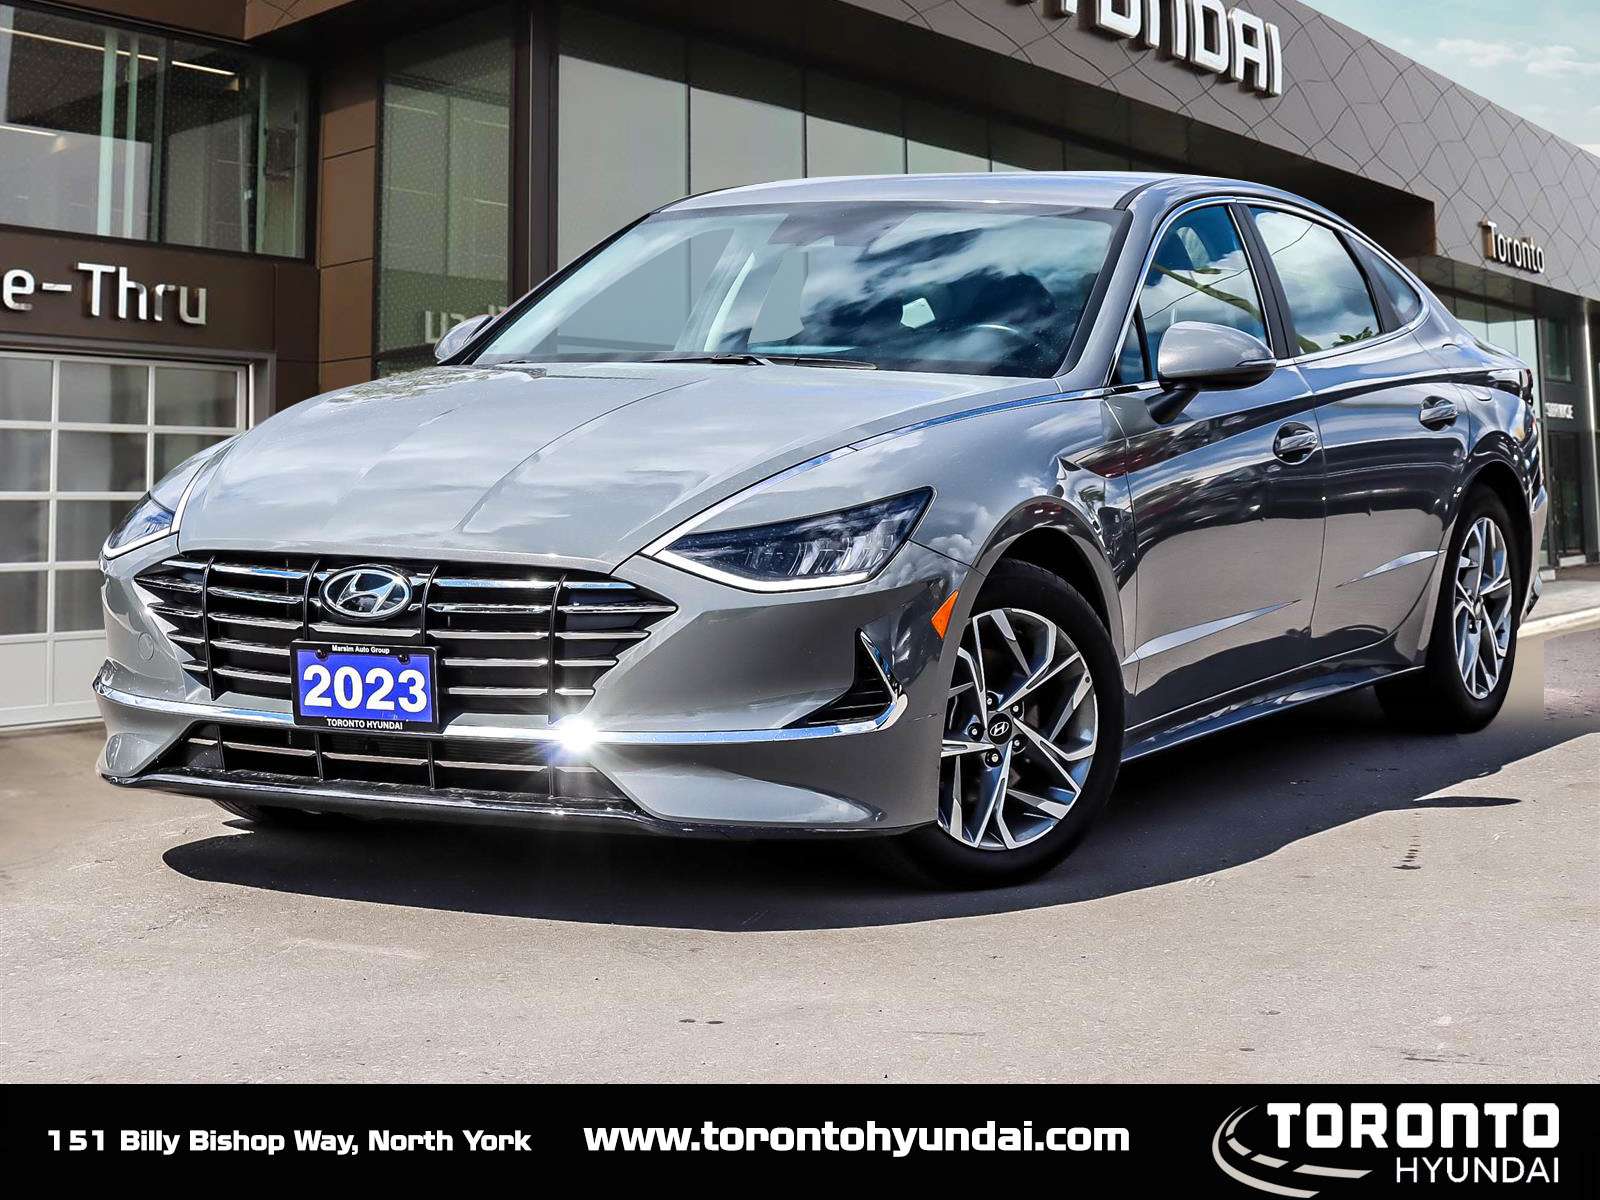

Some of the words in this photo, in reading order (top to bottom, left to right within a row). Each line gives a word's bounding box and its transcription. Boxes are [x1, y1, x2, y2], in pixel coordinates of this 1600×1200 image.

[1061, 0, 1282, 96] NDAI
[1481, 219, 1545, 273] Toronto
[3, 262, 206, 325] e-Thru
[370, 647, 390, 655] Group
[303, 664, 427, 713] 2023
[326, 718, 366, 729] TORONTO
[366, 720, 403, 731] HYUNDAI
